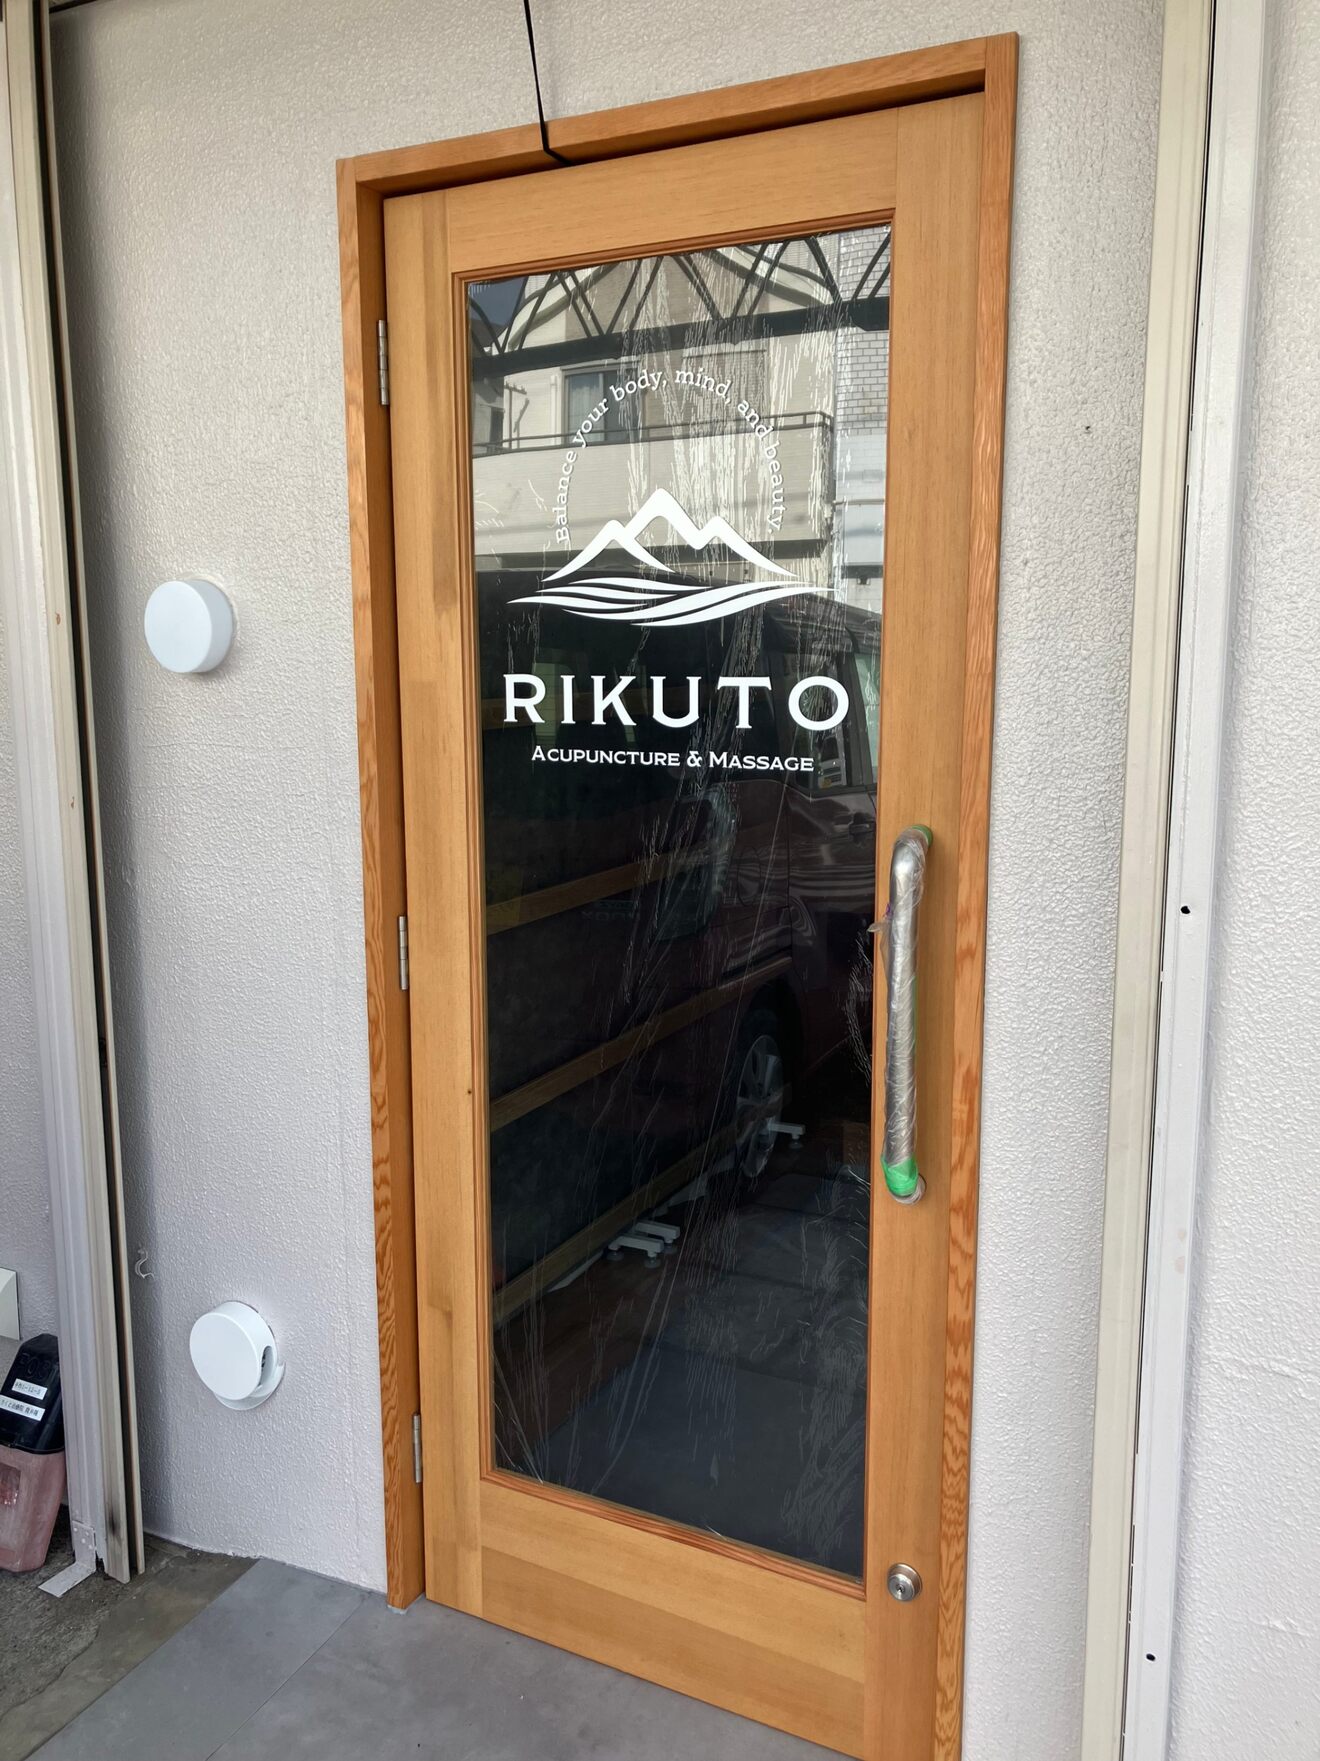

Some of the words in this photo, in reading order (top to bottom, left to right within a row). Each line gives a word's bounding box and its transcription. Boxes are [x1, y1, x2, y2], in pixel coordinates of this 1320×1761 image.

[552, 450, 577, 544] Balance
[572, 398, 609, 448] your
[610, 369, 667, 402] body,
[675, 367, 732, 404] mind,
[737, 399, 774, 441] and
[764, 440, 786, 534] beauty.
[503, 673, 850, 731] RIKUTO
[686, 751, 703, 768] &
